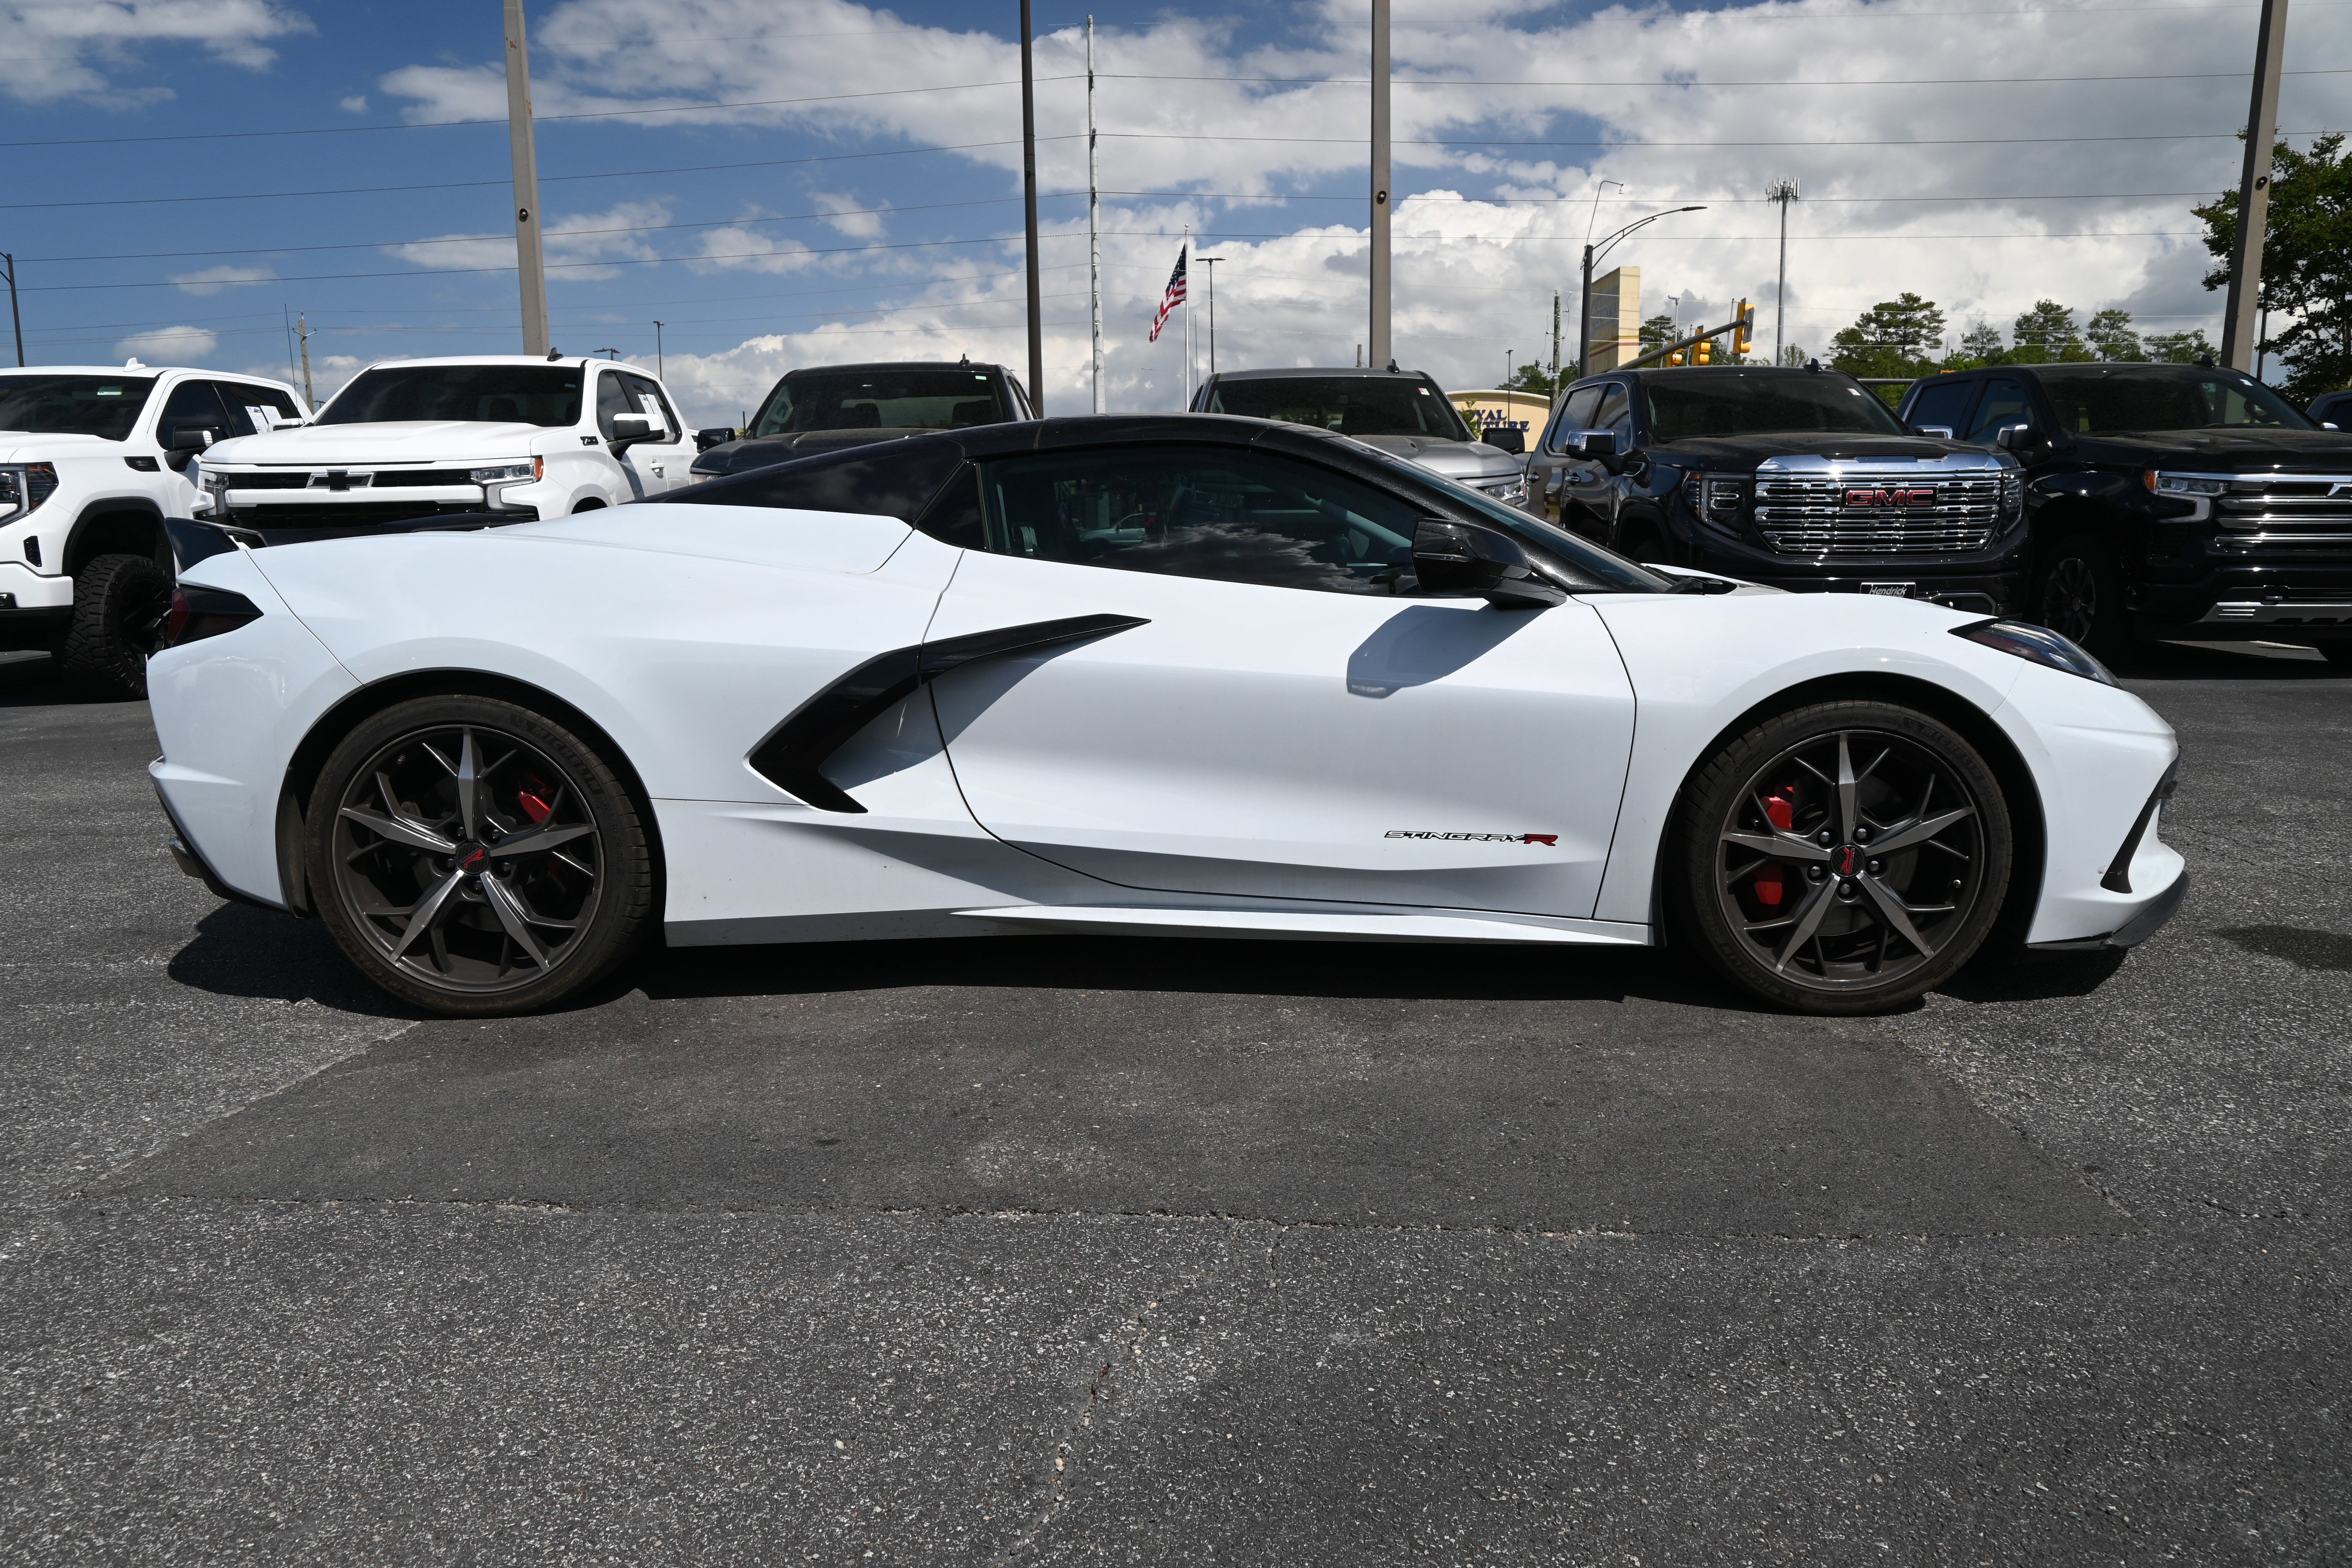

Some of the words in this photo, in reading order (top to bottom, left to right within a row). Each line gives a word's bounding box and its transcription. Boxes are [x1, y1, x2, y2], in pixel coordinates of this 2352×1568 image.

[1846, 490, 1933, 506] GMC
[1869, 586, 1907, 595] Hendrick
[531, 725, 602, 790] MICHELIN
[1922, 726, 1982, 777] MICHELIN
[603, 803, 619, 833] 305/30
[615, 837, 623, 848] ZR
[617, 852, 623, 861] 20
[1697, 843, 1705, 873] SEASON
[1699, 893, 1711, 916] SPORT
[1707, 919, 1719, 939] PILOT
[1722, 946, 1782, 994] MICHELIN
